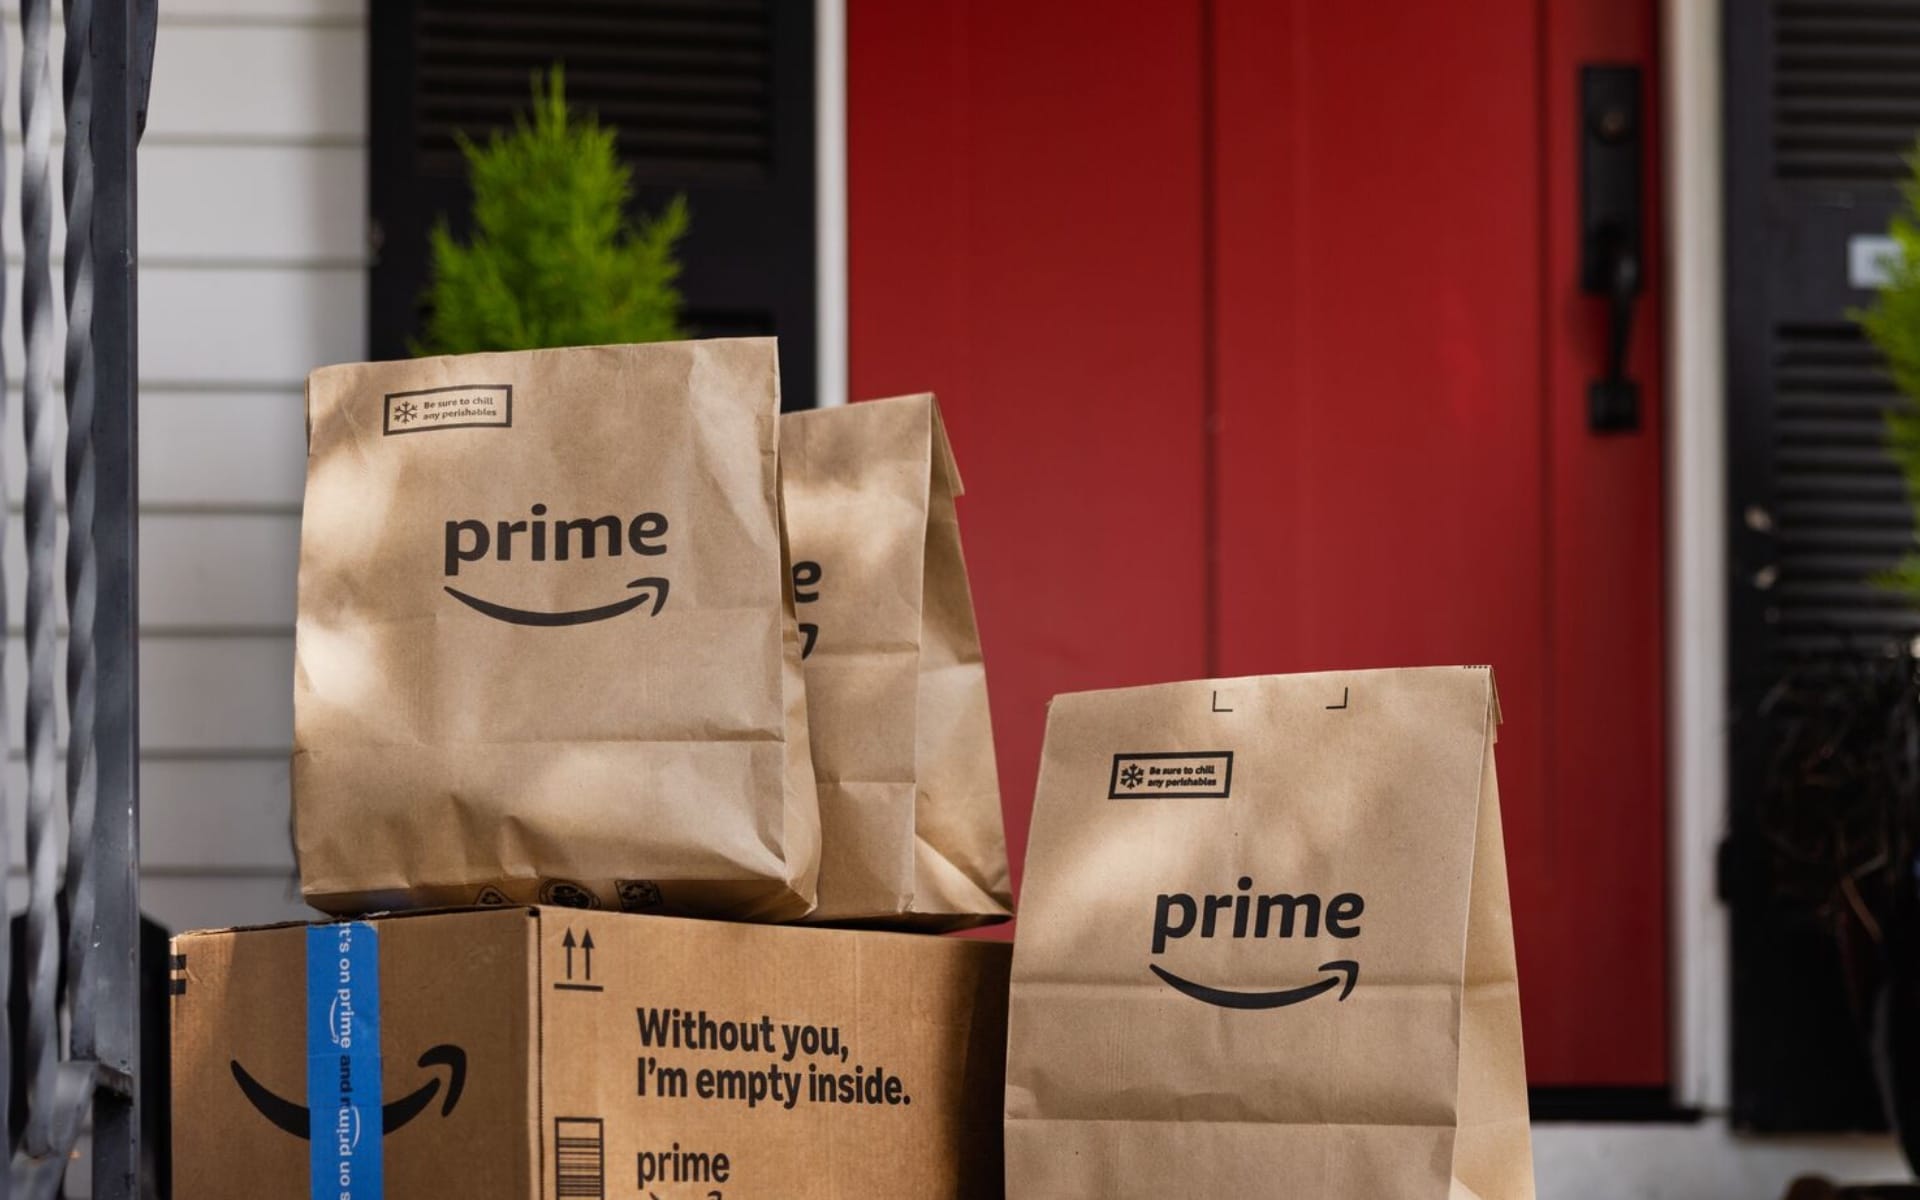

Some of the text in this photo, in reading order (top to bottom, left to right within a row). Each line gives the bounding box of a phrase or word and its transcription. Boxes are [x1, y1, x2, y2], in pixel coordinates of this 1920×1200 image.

[423, 408, 497, 421] any perishables
[424, 396, 494, 410] Be sure to chill
[445, 503, 669, 576] prime
[1147, 777, 1217, 789] any perishables
[1149, 764, 1215, 776] Be sure to chill
[1151, 876, 1365, 954] prime
[339, 958, 351, 983] on
[338, 988, 355, 1049] prime
[636, 1007, 849, 1063] Without you,
[340, 1055, 352, 1093] and
[637, 1057, 911, 1110] I'm empty inside.
[339, 1161, 351, 1187] on
[637, 1142, 730, 1190] prime
